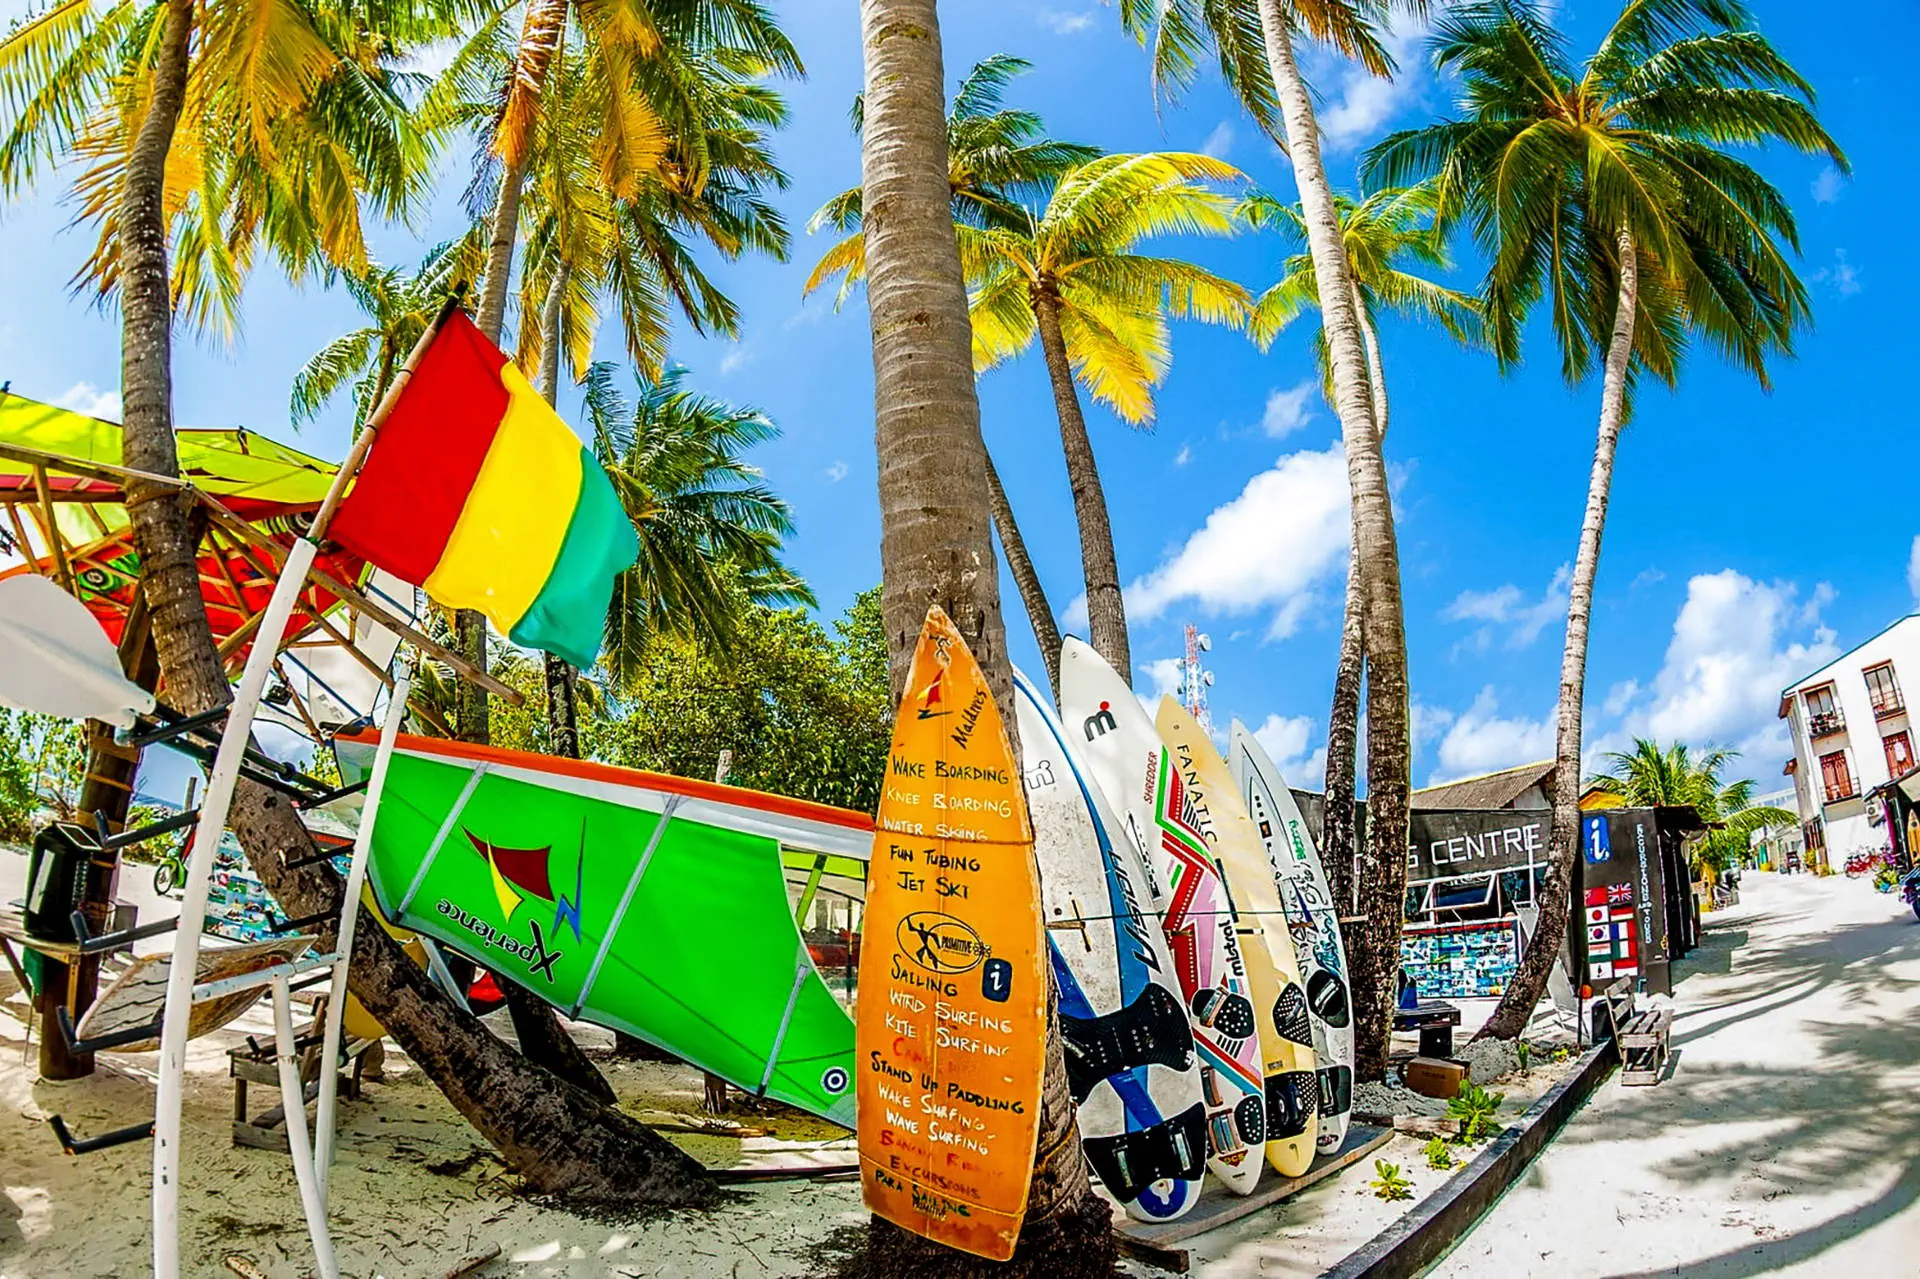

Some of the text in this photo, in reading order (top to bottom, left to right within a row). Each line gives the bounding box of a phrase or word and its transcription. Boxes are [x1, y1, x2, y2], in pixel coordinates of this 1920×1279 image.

[892, 755, 1009, 784] WAKE BOARDING
[1144, 751, 1158, 804] SHREDDER
[886, 785, 1012, 818] KNEE BOARDING
[1177, 744, 1218, 842] FANATIC
[883, 816, 924, 836] WATER
[1431, 823, 1544, 866] CENTRE
[890, 845, 981, 872] FUN TUBING
[897, 871, 969, 899] JET SKI
[436, 898, 563, 984] Xperience
[1218, 920, 1244, 977] mistral
[891, 954, 958, 997] SAILING
[886, 1012, 916, 1038] KITE
[935, 1001, 1013, 1034] SURFING
[870, 1051, 913, 1083] STAND
[921, 1073, 938, 1092] UP
[948, 1083, 1024, 1114] PADDLING
[878, 1082, 985, 1130] WAKE SURFING
[886, 1108, 919, 1134] WAVE
[928, 1121, 989, 1155] SURFING
[875, 1169, 904, 1192] PARA
